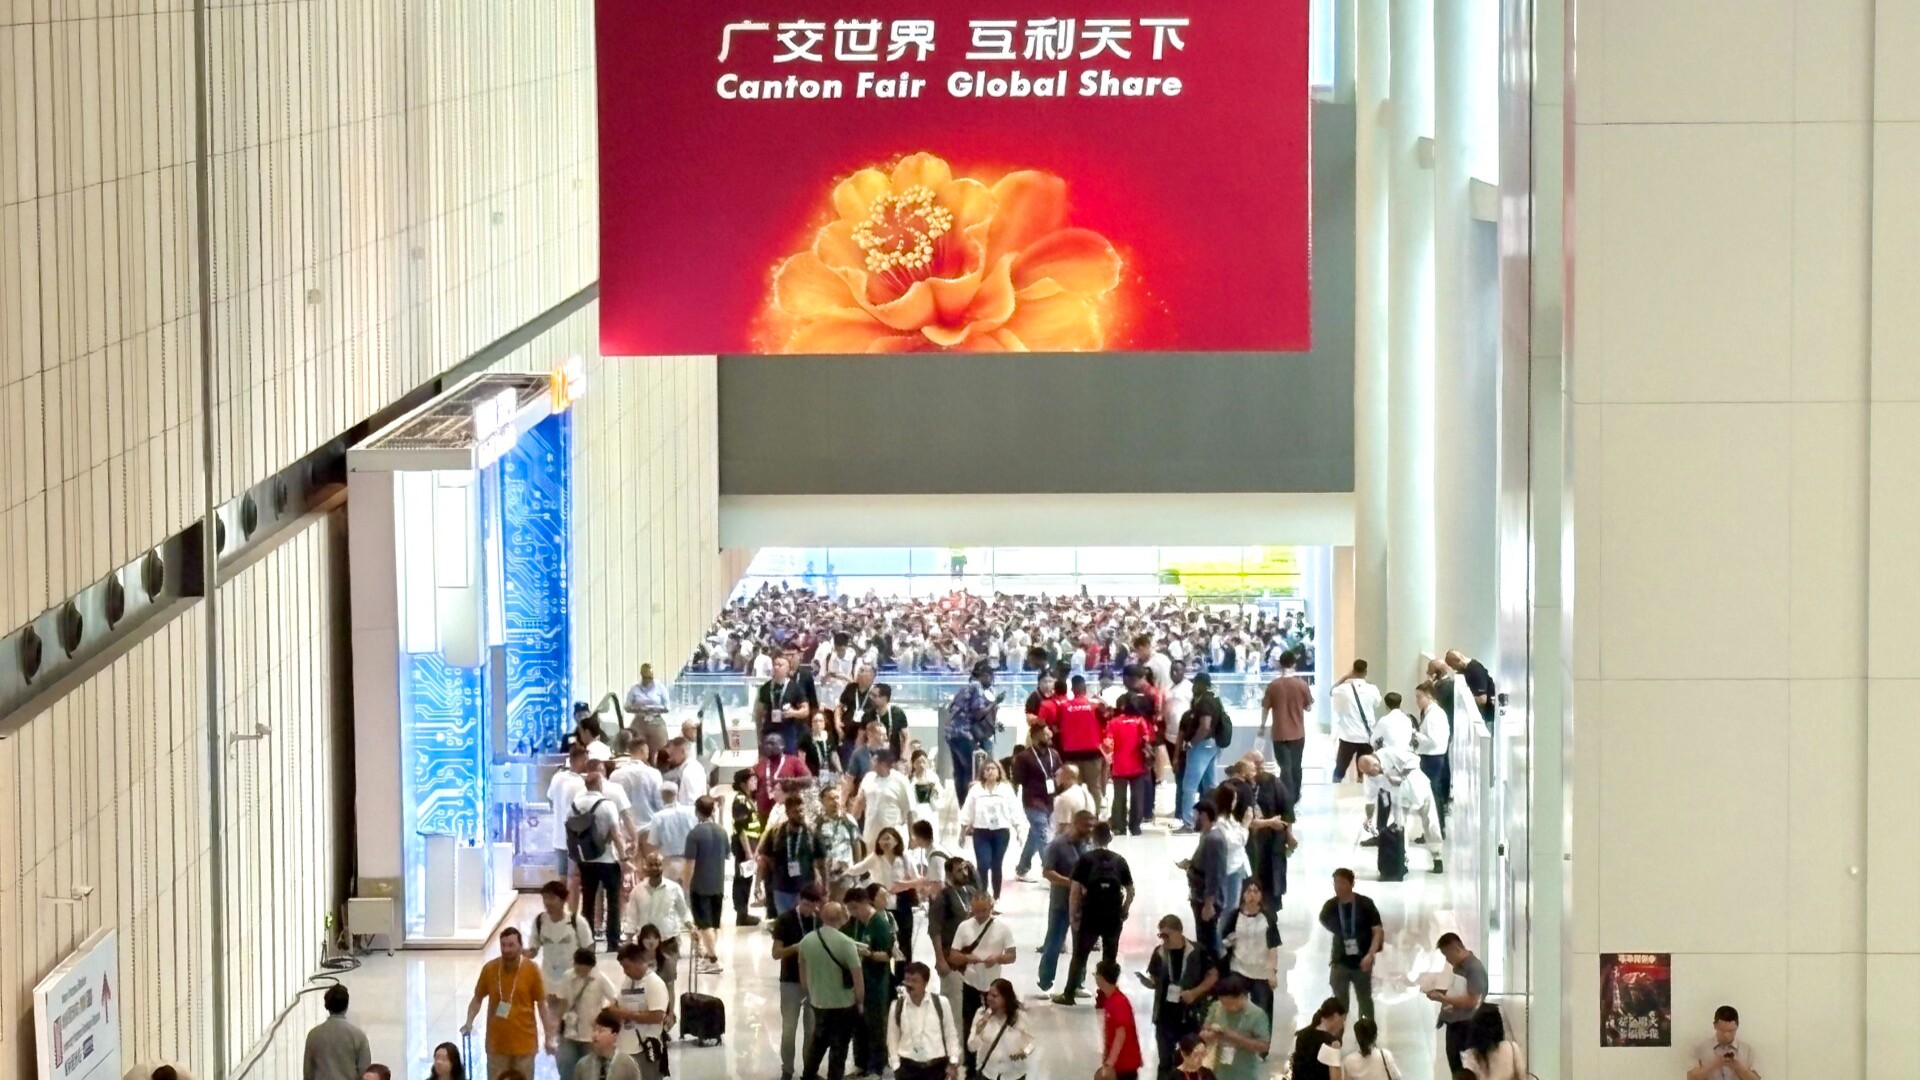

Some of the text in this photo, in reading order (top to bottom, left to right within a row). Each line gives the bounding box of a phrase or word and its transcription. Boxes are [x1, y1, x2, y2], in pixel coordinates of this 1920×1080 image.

[717, 17, 1190, 63] 广交世界 互利天下
[716, 69, 1183, 99] Canton Fair Global Share
